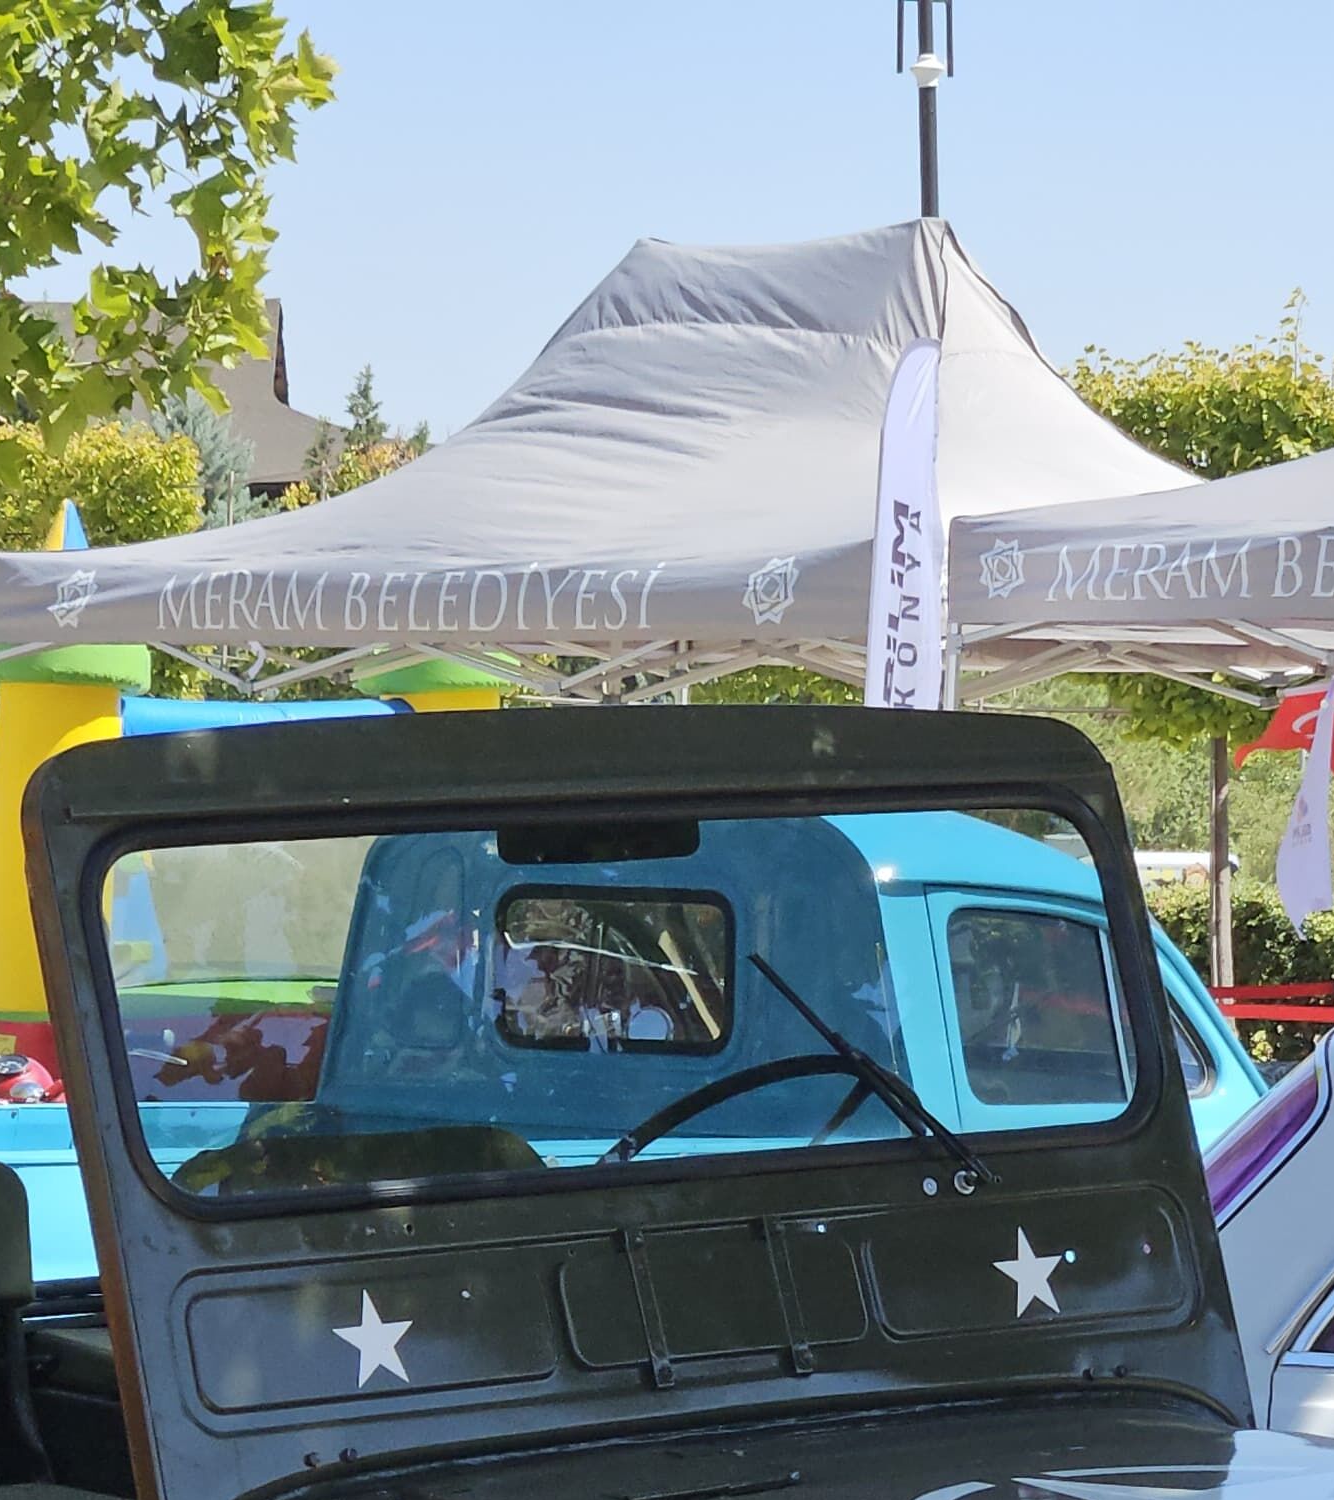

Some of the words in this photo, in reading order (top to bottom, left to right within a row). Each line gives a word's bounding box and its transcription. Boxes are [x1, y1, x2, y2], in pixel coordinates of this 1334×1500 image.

[156, 569, 330, 632] MERAM
[344, 562, 665, 632] BELEDİYESİ
[1045, 538, 1252, 602] MERAM
[893, 511, 922, 710] KONYA
